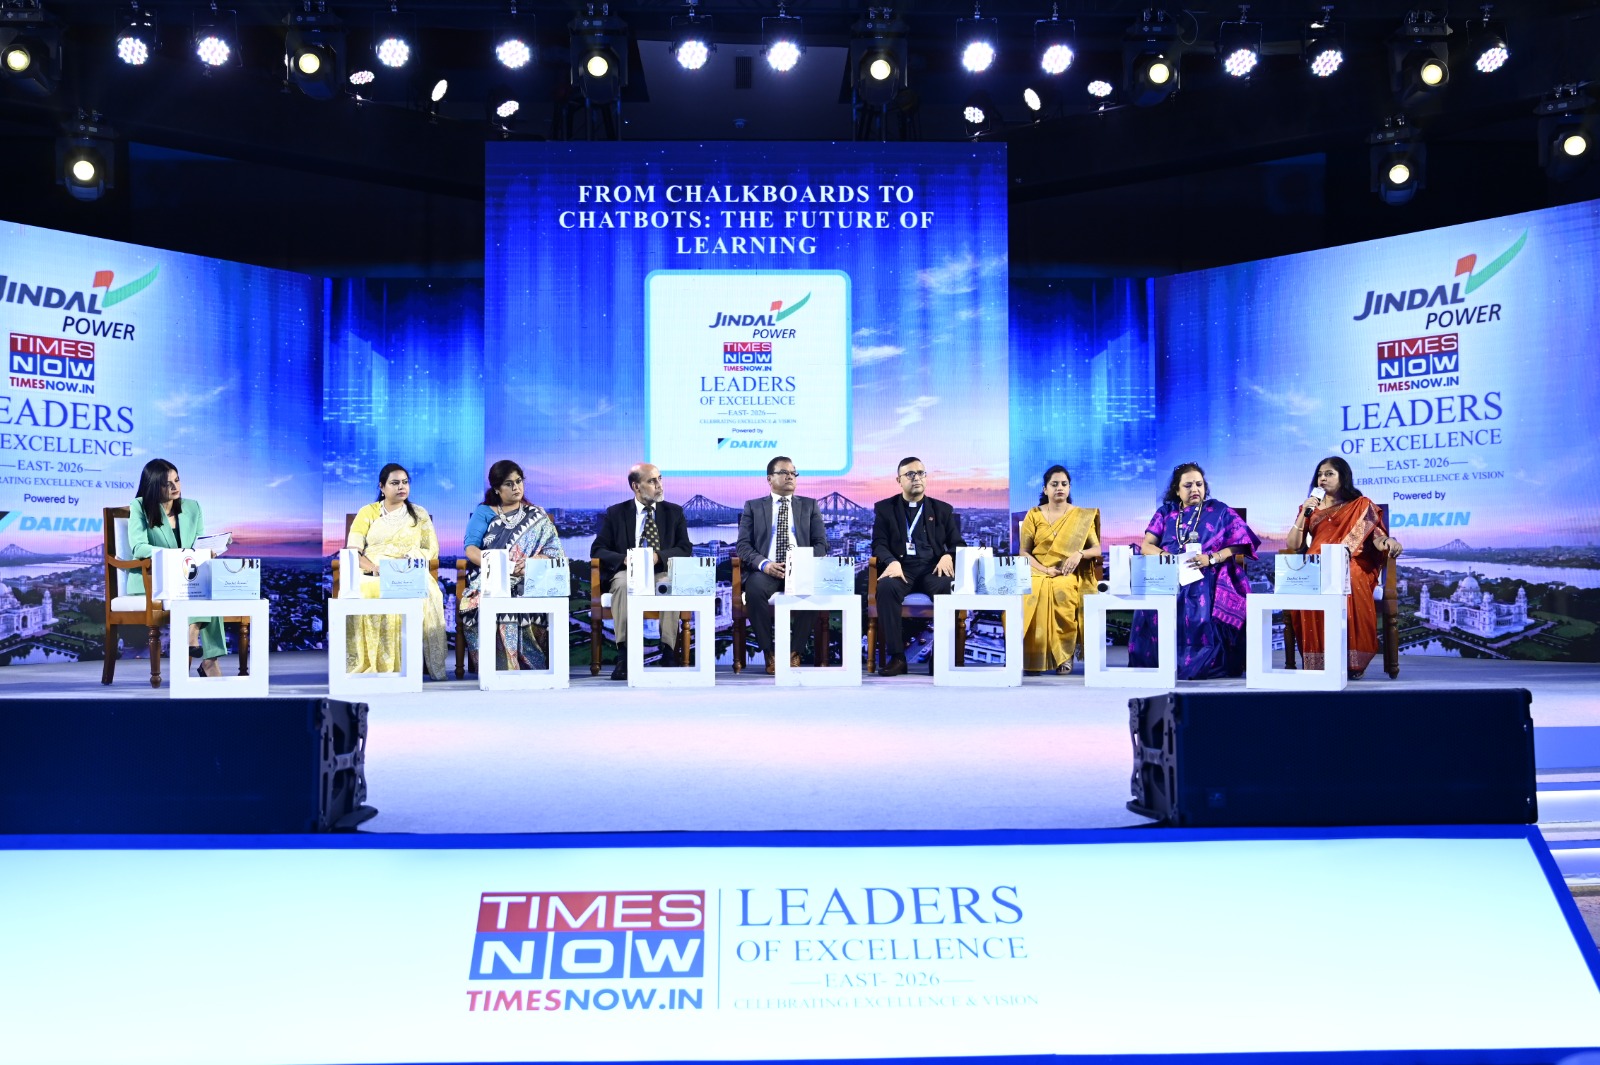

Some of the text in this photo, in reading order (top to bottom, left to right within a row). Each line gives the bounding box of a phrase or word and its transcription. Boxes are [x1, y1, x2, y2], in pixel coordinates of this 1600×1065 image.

[578, 184, 914, 203] FROM CHALKBOARDS TO
[558, 210, 935, 229] CHATBOTS: THE FUTURE OF
[676, 236, 818, 255] LEARNING
[1353, 282, 1465, 320] JINDAL
[709, 312, 776, 328] JINDAL
[1425, 304, 1502, 330] POWER
[62, 316, 135, 340] POWER
[752, 329, 796, 338] POWER
[11, 335, 94, 358] TIMES
[724, 342, 771, 352] TIMES
[1378, 335, 1458, 358] TIMES
[13, 354, 93, 378] NOW
[725, 354, 771, 362] NOW
[1381, 355, 1458, 378] NOW
[10, 376, 94, 394] TIMESNOW.IN
[700, 376, 796, 392] LEADERS
[1378, 376, 1459, 392] TIMESNOW.IN
[700, 396, 796, 406] OF EXCELLENCE
[1340, 392, 1502, 432] LEADERS
[0, 434, 133, 456] EXCELLENCE
[730, 440, 778, 448] DAIKIN
[1341, 428, 1502, 455] OF EXCELLENCE
[18, 460, 84, 473] EAST- 2026
[1386, 458, 1450, 470] EAST- 2026
[34, 478, 94, 488] EXCELLENCE
[104, 480, 134, 489] VISION
[1402, 473, 1460, 484] EXCELLENCE
[1472, 471, 1504, 480] VISION
[24, 494, 79, 506] Powered by
[1393, 491, 1446, 500] Powered by
[19, 516, 102, 532] DAIKIN
[1390, 512, 1470, 528] DAIKIN
[482, 894, 702, 930] TIMES
[736, 885, 1023, 926] LEADERS
[480, 938, 701, 976] NOW
[736, 936, 1028, 962] OF EXCELLENCE
[825, 972, 940, 988] EAST- 2026
[466, 988, 704, 1012] TIMESNOW.IN
[734, 994, 1038, 1010] CELEBRATING EXCELLENCE & VISION
